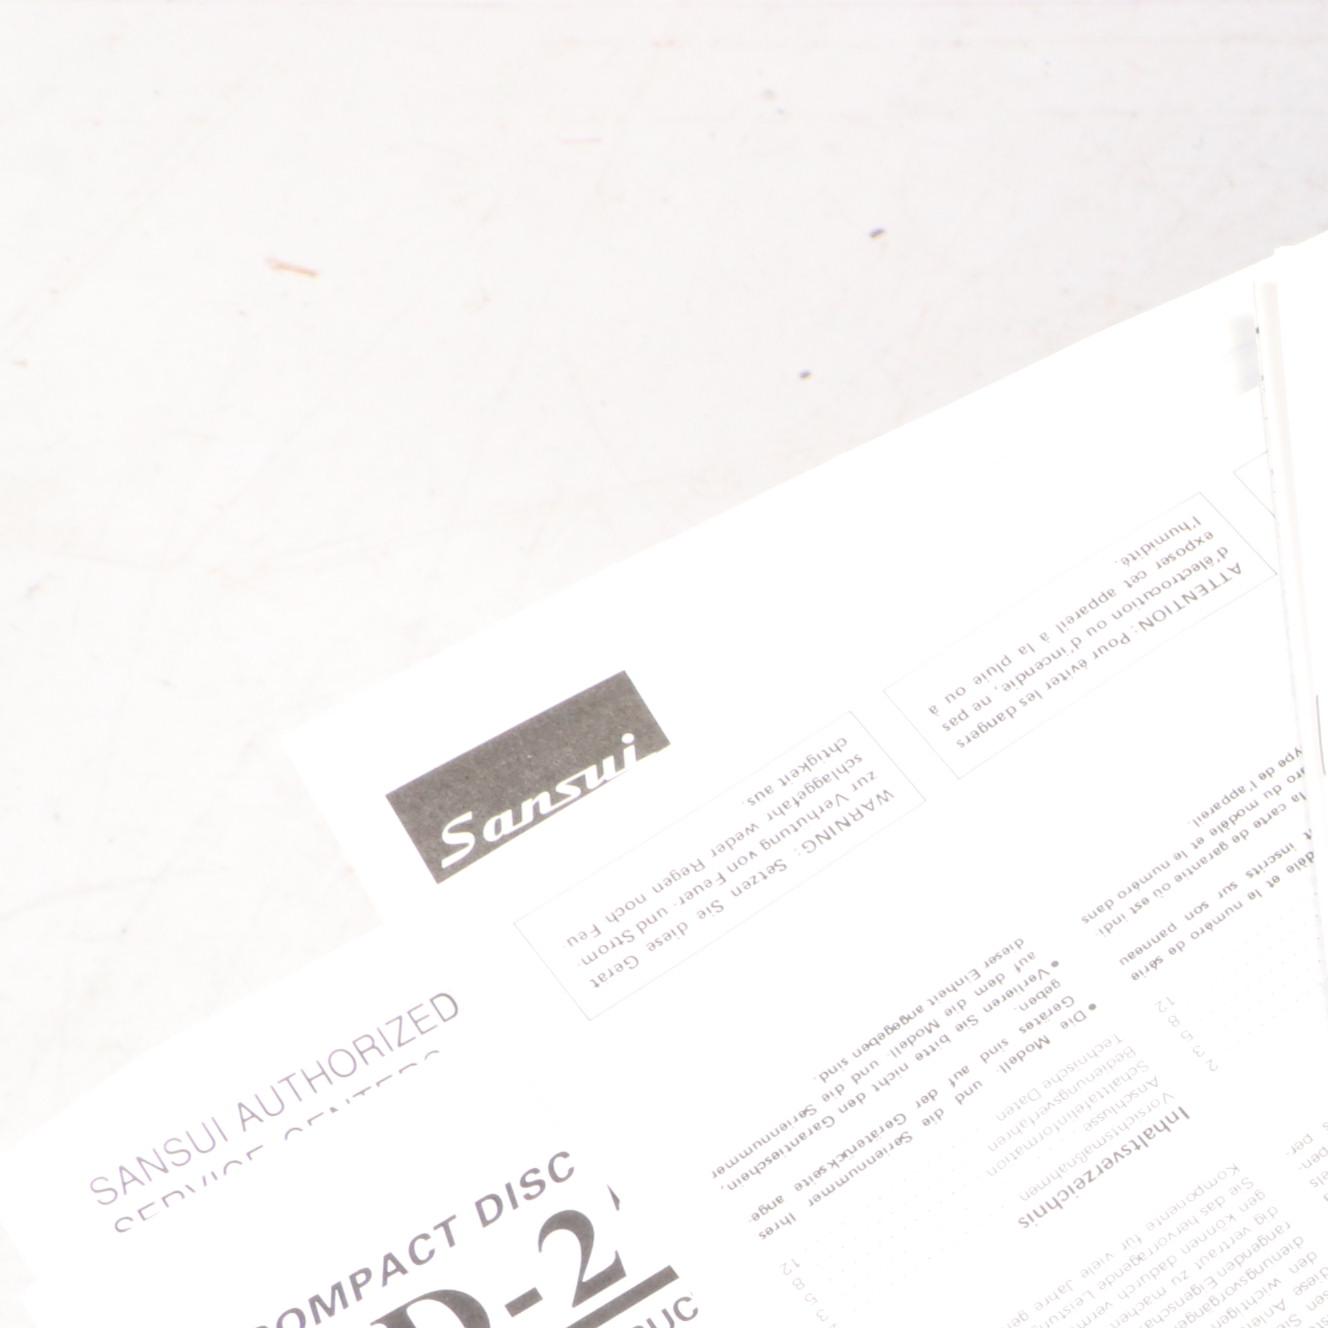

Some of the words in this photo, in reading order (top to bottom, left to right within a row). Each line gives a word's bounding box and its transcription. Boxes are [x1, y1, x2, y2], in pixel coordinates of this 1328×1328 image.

[1153, 529, 1215, 571] exposer
[1121, 568, 1148, 589] cet
[1054, 586, 1118, 635] appareil
[1037, 630, 1050, 644] à
[1084, 618, 1108, 637] ou
[1016, 641, 1036, 656] la
[1090, 630, 1132, 661] Pour
[971, 653, 1013, 686] pluie
[926, 703, 940, 717] à
[942, 685, 967, 705] ou
[970, 694, 993, 712] ne
[1017, 688, 1044, 708] les
[940, 707, 971, 732] pas
[954, 704, 1018, 749] dangers
[775, 736, 848, 788] chtigkeit
[765, 752, 864, 822] schlaggefahr
[849, 769, 876, 793] zur
[440, 732, 648, 868] Sansui
[708, 821, 761, 858] weder
[650, 856, 707, 894] Regen
[724, 849, 759, 873] von
[728, 857, 788, 897] Setzen
[603, 892, 648, 924] noch
[634, 906, 669, 935] und
[695, 898, 725, 920] Sie
[644, 920, 689, 952] diese
[88, 1115, 229, 1206] SANSUI
[236, 991, 459, 1133] AUTHORIZED
[1016, 1105, 1190, 1229] Inhaltsverzeichnis
[473, 1150, 575, 1228] DISC
